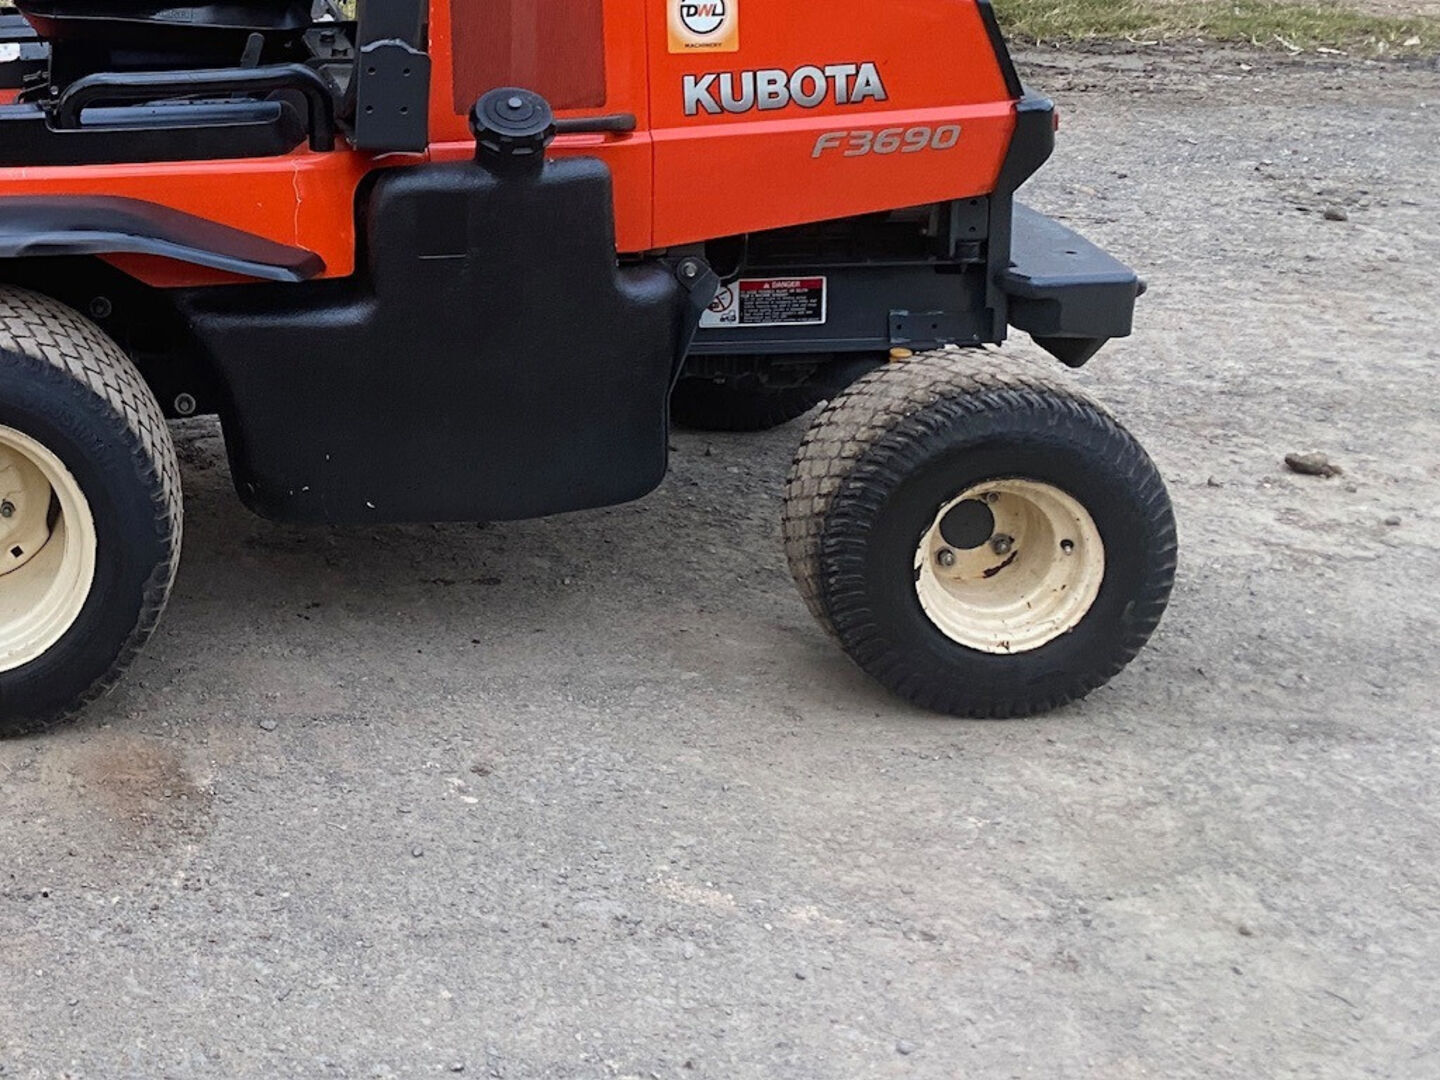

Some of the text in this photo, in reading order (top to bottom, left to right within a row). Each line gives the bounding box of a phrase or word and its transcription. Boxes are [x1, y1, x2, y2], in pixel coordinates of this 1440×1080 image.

[681, 4, 724, 18] DWL
[682, 61, 888, 117] KUBOTA
[811, 124, 961, 159] F3690
